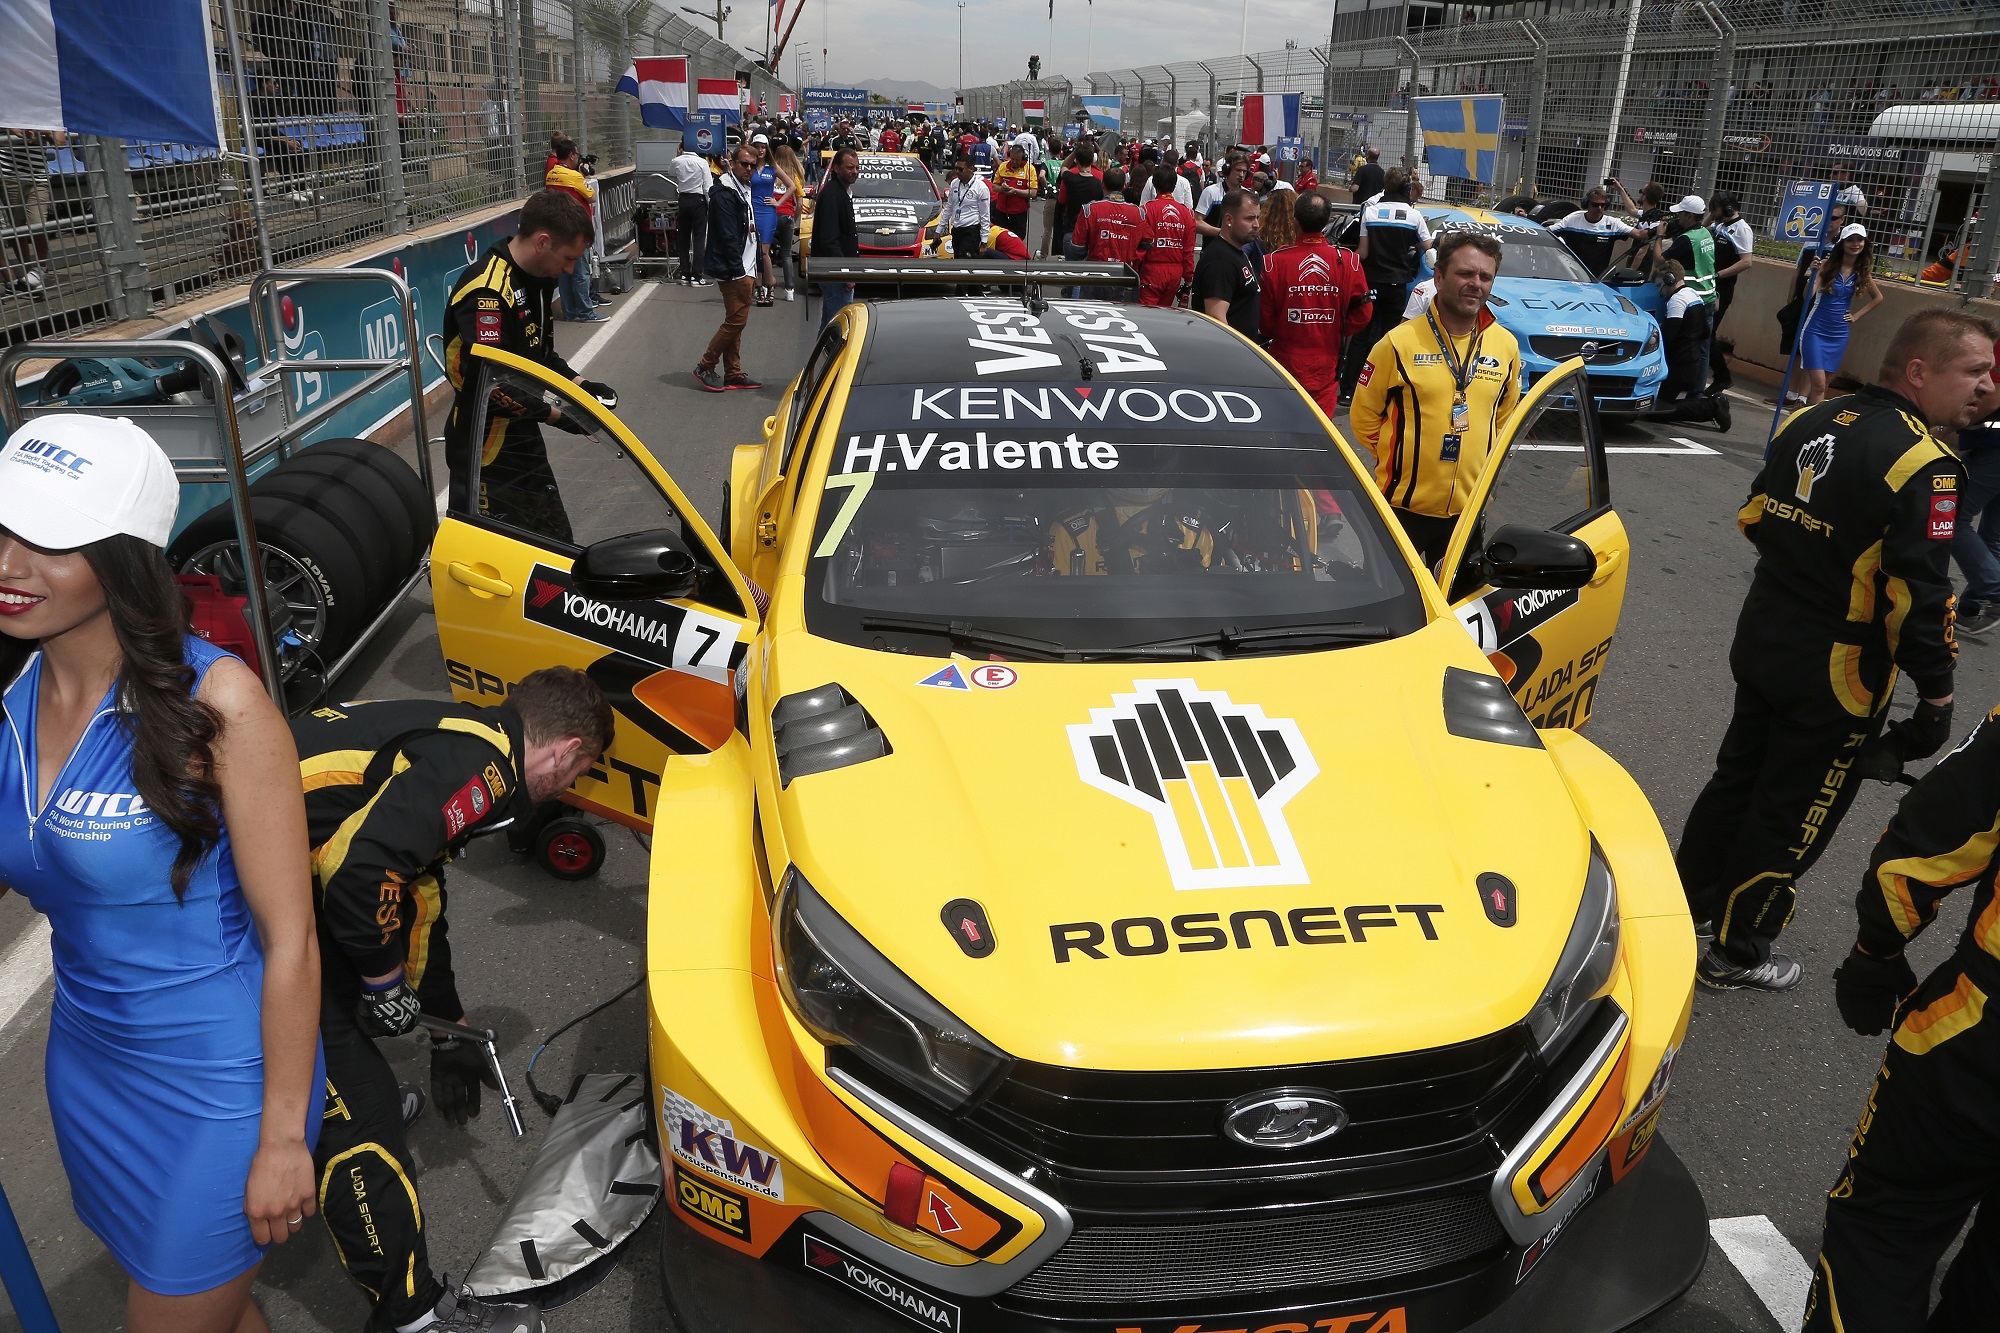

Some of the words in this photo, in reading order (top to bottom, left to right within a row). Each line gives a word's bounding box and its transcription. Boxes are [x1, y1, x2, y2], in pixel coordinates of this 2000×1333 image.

[697, 128, 713, 151] 9
[1280, 146, 1299, 161] 63
[1109, 231, 1130, 241] TOTAL
[1443, 221, 1539, 236] KENWOOD
[1785, 205, 1824, 239] 62
[1288, 284, 1339, 293] CITROËN
[478, 300, 500, 309] OMP
[1302, 312, 1332, 321] TOTAL
[1584, 326, 1629, 337] EDGE
[1414, 353, 1443, 361] WTCC
[911, 387, 1262, 424] KENWOOD
[20, 438, 93, 475] WTCC
[842, 432, 1120, 474] H.Valente
[1445, 442, 1457, 452] VIP
[9, 456, 51, 474] Championship
[24, 452, 41, 462] World
[42, 458, 66, 475] Touring
[67, 471, 80, 481] Car
[1932, 476, 1956, 490] OMP
[813, 472, 877, 559] 7
[1932, 521, 1954, 531] LADA
[300, 556, 335, 606] ADVAN
[270, 602, 286, 618] ONDA
[563, 592, 668, 647] YOKOHAMA
[688, 624, 720, 667] 7
[1466, 612, 1484, 650] 7
[987, 669, 1004, 681] E
[1523, 659, 1573, 713] LADA
[55, 787, 152, 818] WTCC
[452, 800, 466, 832] LADA
[44, 818, 112, 842] Championship
[48, 809, 59, 822] FIA
[59, 814, 85, 829] World
[87, 820, 131, 830] Touring
[134, 817, 154, 826] Car
[1049, 904, 1445, 964] ROSNEFT
[680, 1118, 779, 1185] KW
[673, 1144, 779, 1199] kwsuspensions.de
[350, 1166, 366, 1201] LADA
[358, 1202, 384, 1257] SPORT
[680, 1180, 742, 1224] OMP
[843, 1260, 952, 1328] YOKOHAMA
